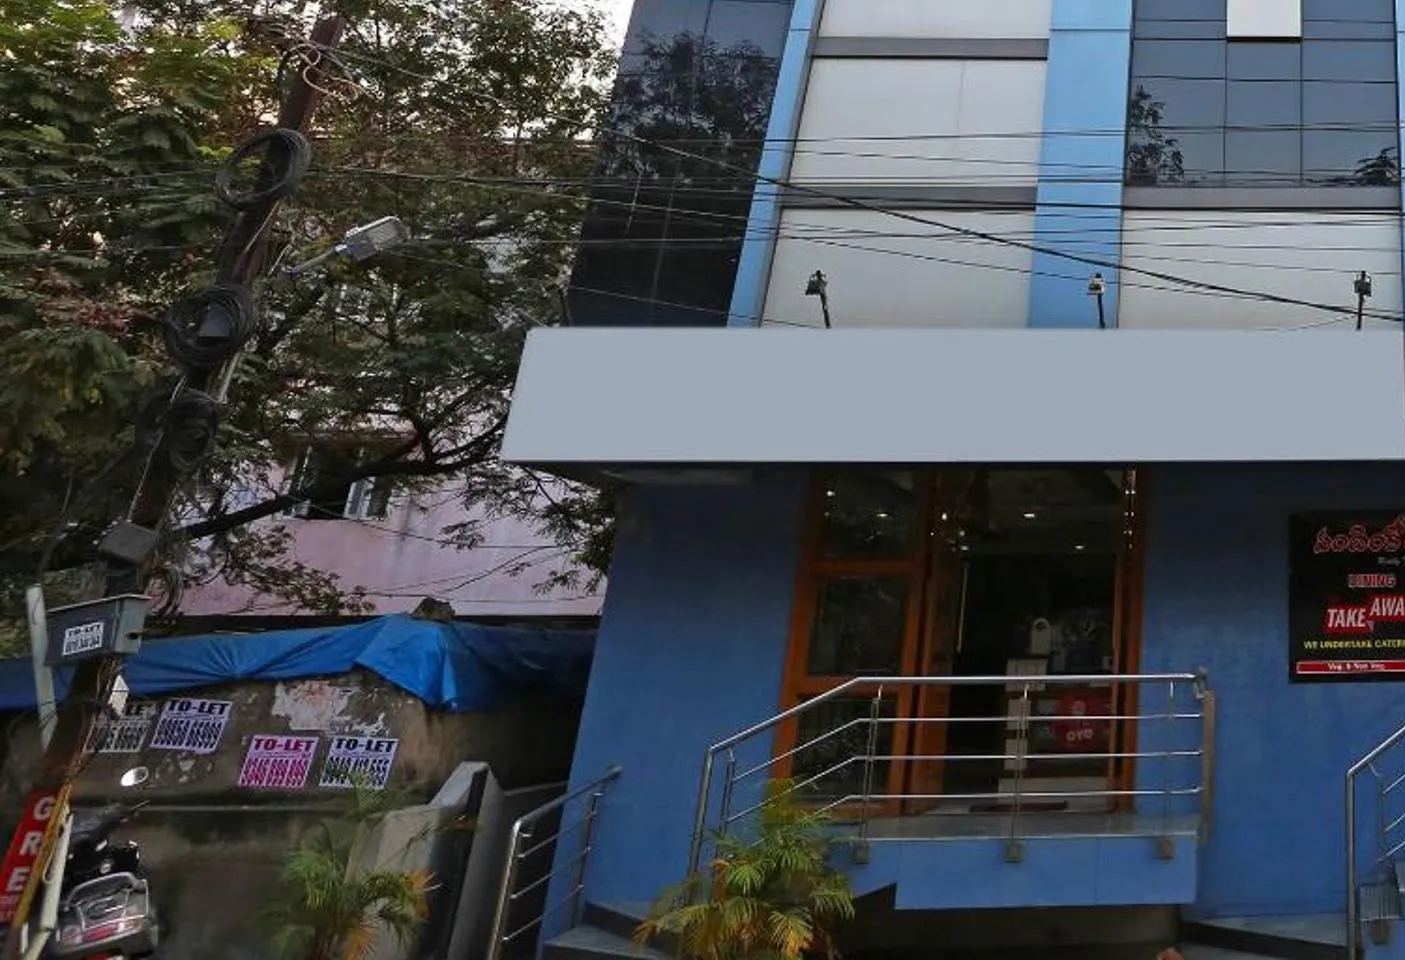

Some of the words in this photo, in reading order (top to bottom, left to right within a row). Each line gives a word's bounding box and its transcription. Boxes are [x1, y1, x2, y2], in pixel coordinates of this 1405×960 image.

[1327, 608, 1366, 627] TAKE
[168, 699, 229, 716] TO-LET
[254, 738, 315, 751] TO-LET
[334, 738, 396, 753] TO-LET
